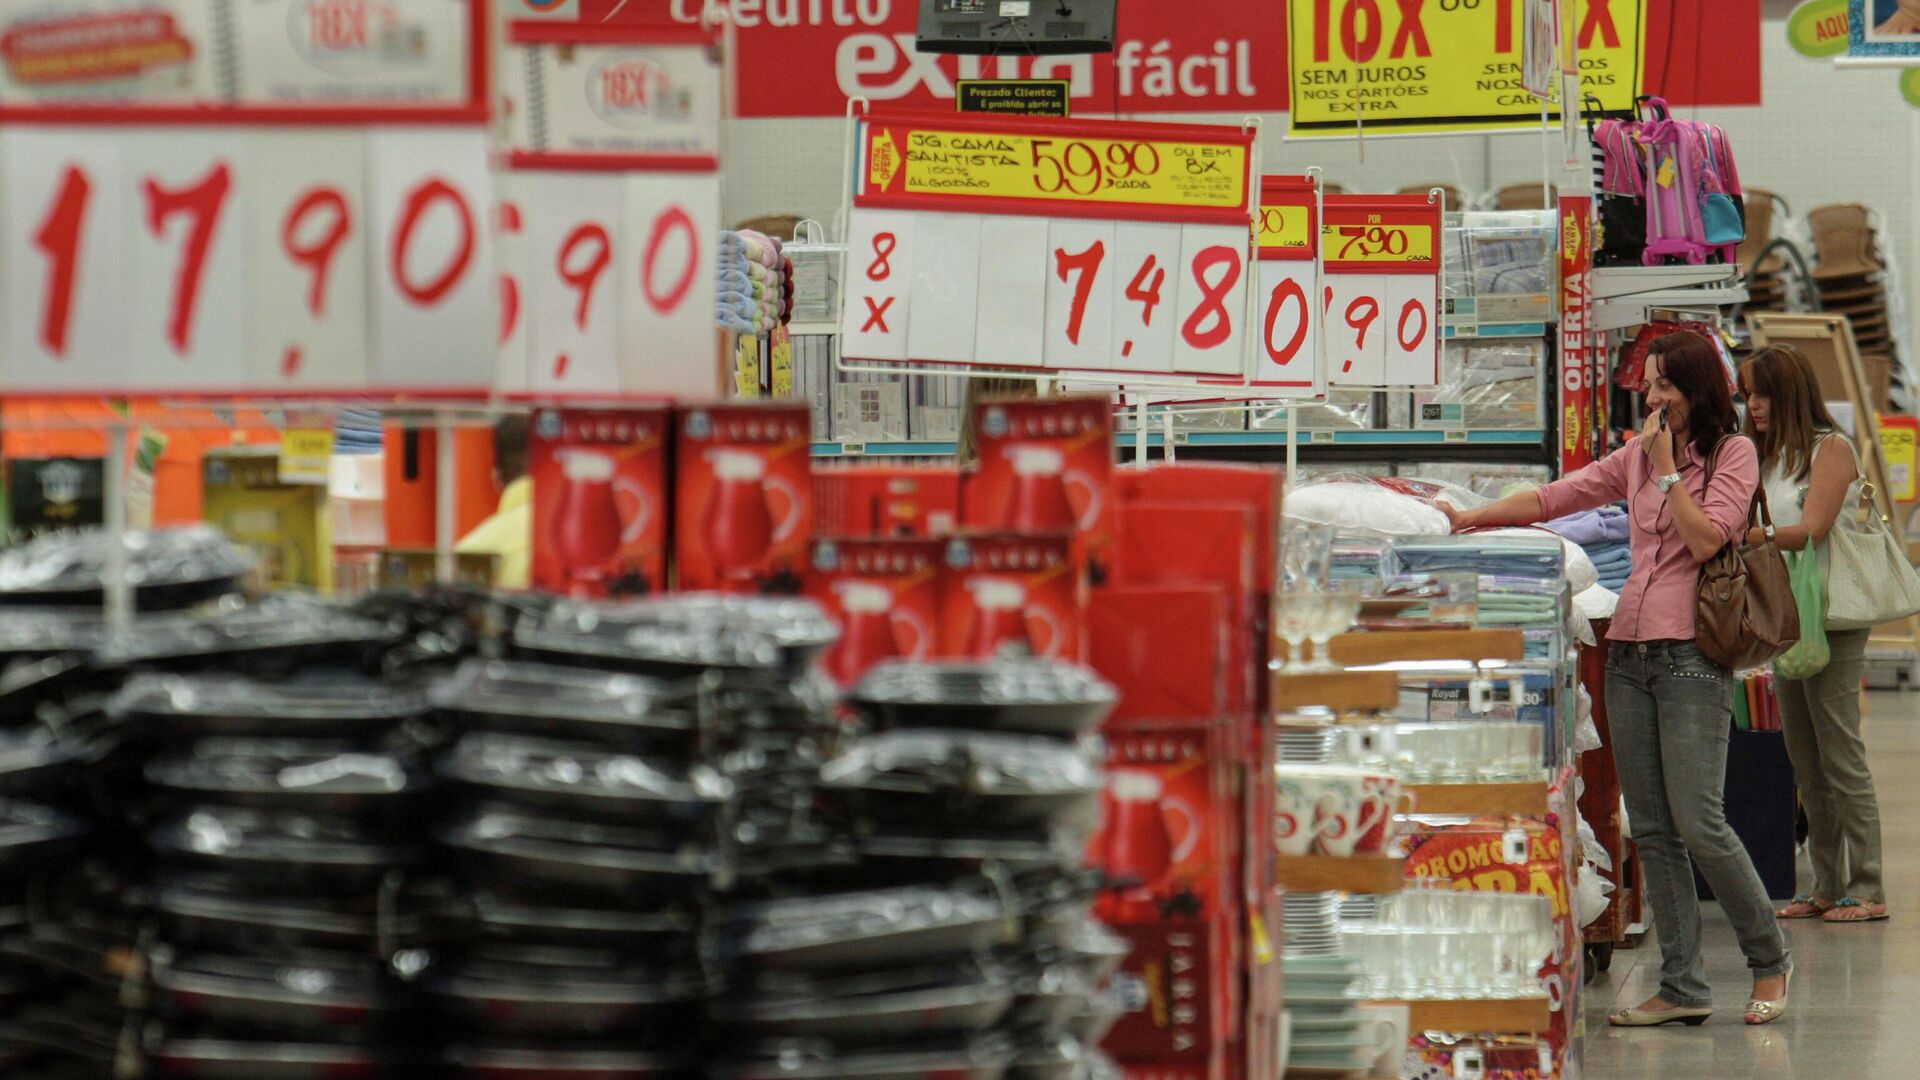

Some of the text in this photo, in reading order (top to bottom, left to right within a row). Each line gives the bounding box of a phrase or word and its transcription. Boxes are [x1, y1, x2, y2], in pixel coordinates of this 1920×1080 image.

[1816, 12, 1849, 42] AQU
[1117, 41, 1255, 98] fácil
[1300, 65, 1427, 86] SEM JUROS
[601, 65, 648, 108] 18X
[969, 88, 1057, 98] Prezado Cliente:
[1303, 84, 1429, 100] NOS CARTÕES
[1476, 79, 1522, 91] NOS
[988, 99, 1025, 109] proibido
[1027, 99, 1049, 108] abrir
[1328, 100, 1398, 112] EXTRA
[950, 138, 1015, 152] CAMA
[1173, 147, 1232, 158] OU EM
[880, 142, 891, 180] OFERTA
[906, 151, 1020, 167] SANTISTA
[1186, 158, 1222, 175] 8X
[927, 166, 969, 177] 100%
[1030, 139, 1160, 196] 59,90
[908, 176, 990, 189] ALGODÃO
[1115, 179, 1151, 189] CADA
[1367, 214, 1381, 225] POR
[1338, 226, 1409, 260] 7,90
[866, 232, 896, 282] 8
[31, 160, 477, 376] 17,90
[1054, 240, 1241, 357] 7,48
[860, 296, 896, 334] X
[1564, 272, 1582, 392] OFERTA
[1431, 689, 1460, 699] Royal
